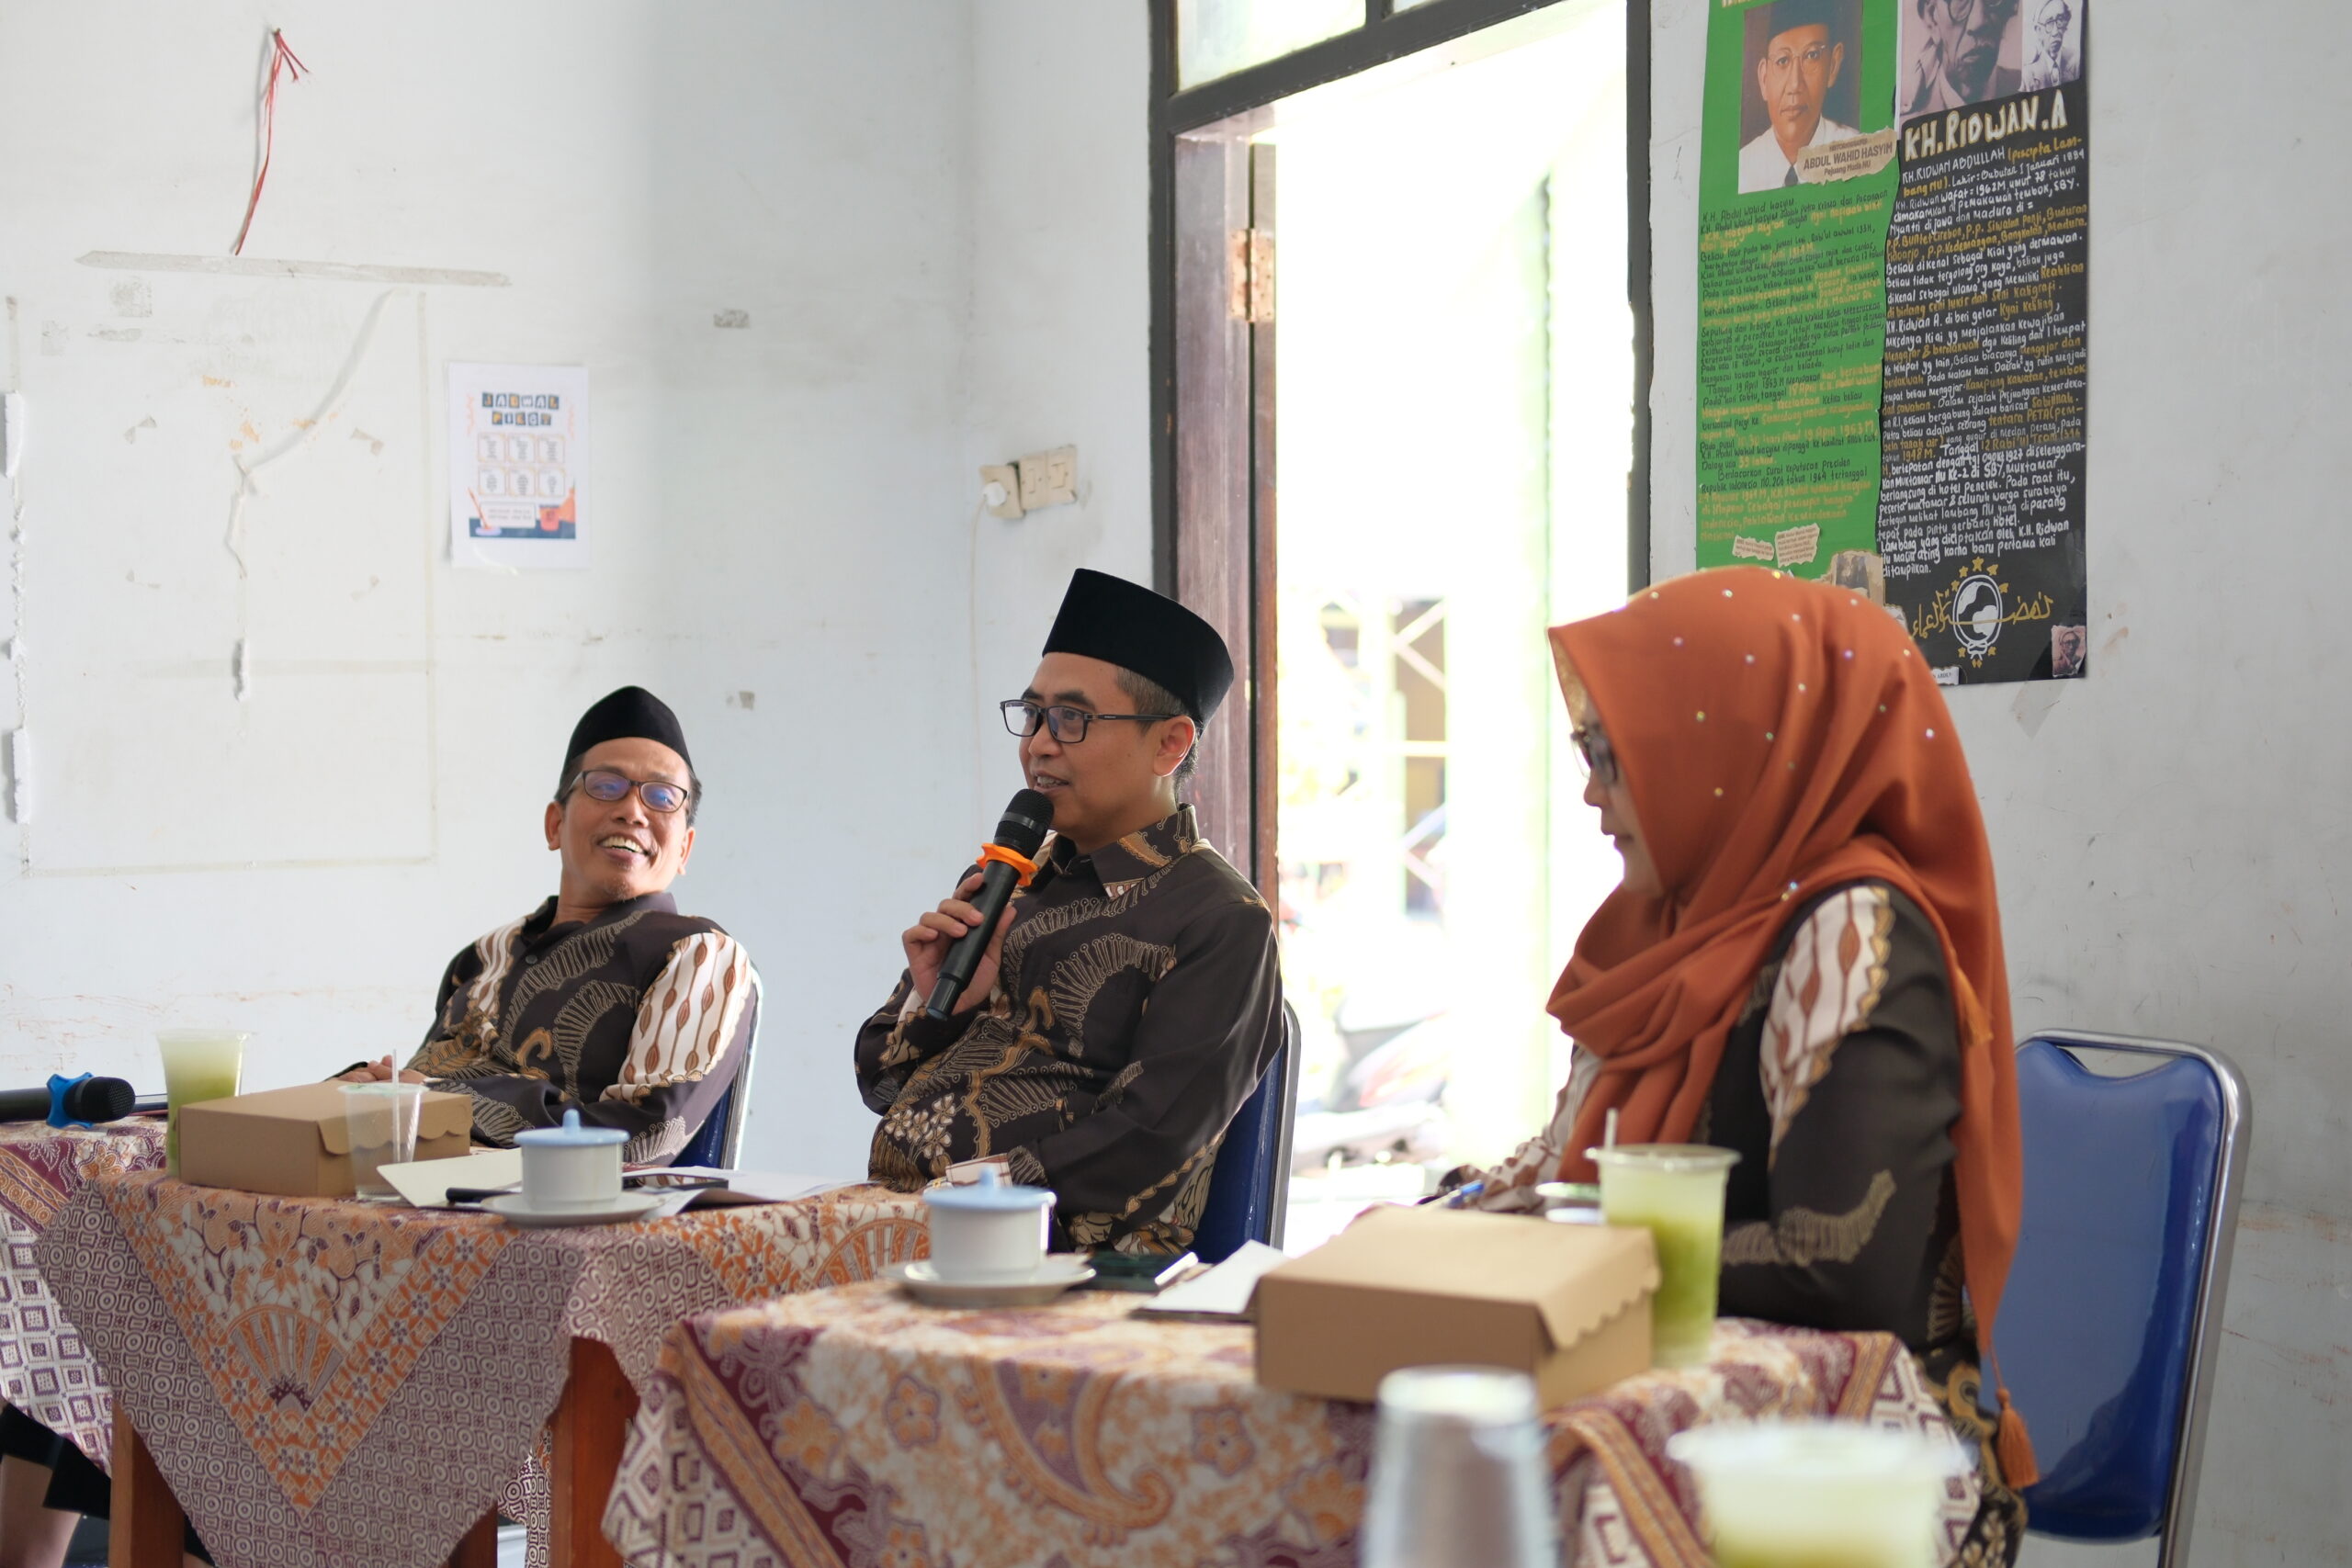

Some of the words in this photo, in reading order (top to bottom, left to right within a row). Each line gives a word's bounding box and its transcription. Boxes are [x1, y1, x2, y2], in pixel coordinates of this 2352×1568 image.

[1804, 155, 1830, 170] ABDUL
[1834, 150, 1860, 164] WAHID
[1861, 141, 1893, 158] HASYIM
[2008, 243, 2027, 260] yang
[2043, 251, 2064, 268] juga
[2062, 336, 2081, 349] dan
[1939, 481, 1961, 495] hotel
[1992, 491, 2019, 504] warga
[1904, 527, 1924, 542] pada
[1920, 536, 1939, 553] yang
[2036, 519, 2069, 536] Ridwan
[1973, 543, 1995, 555] baru
